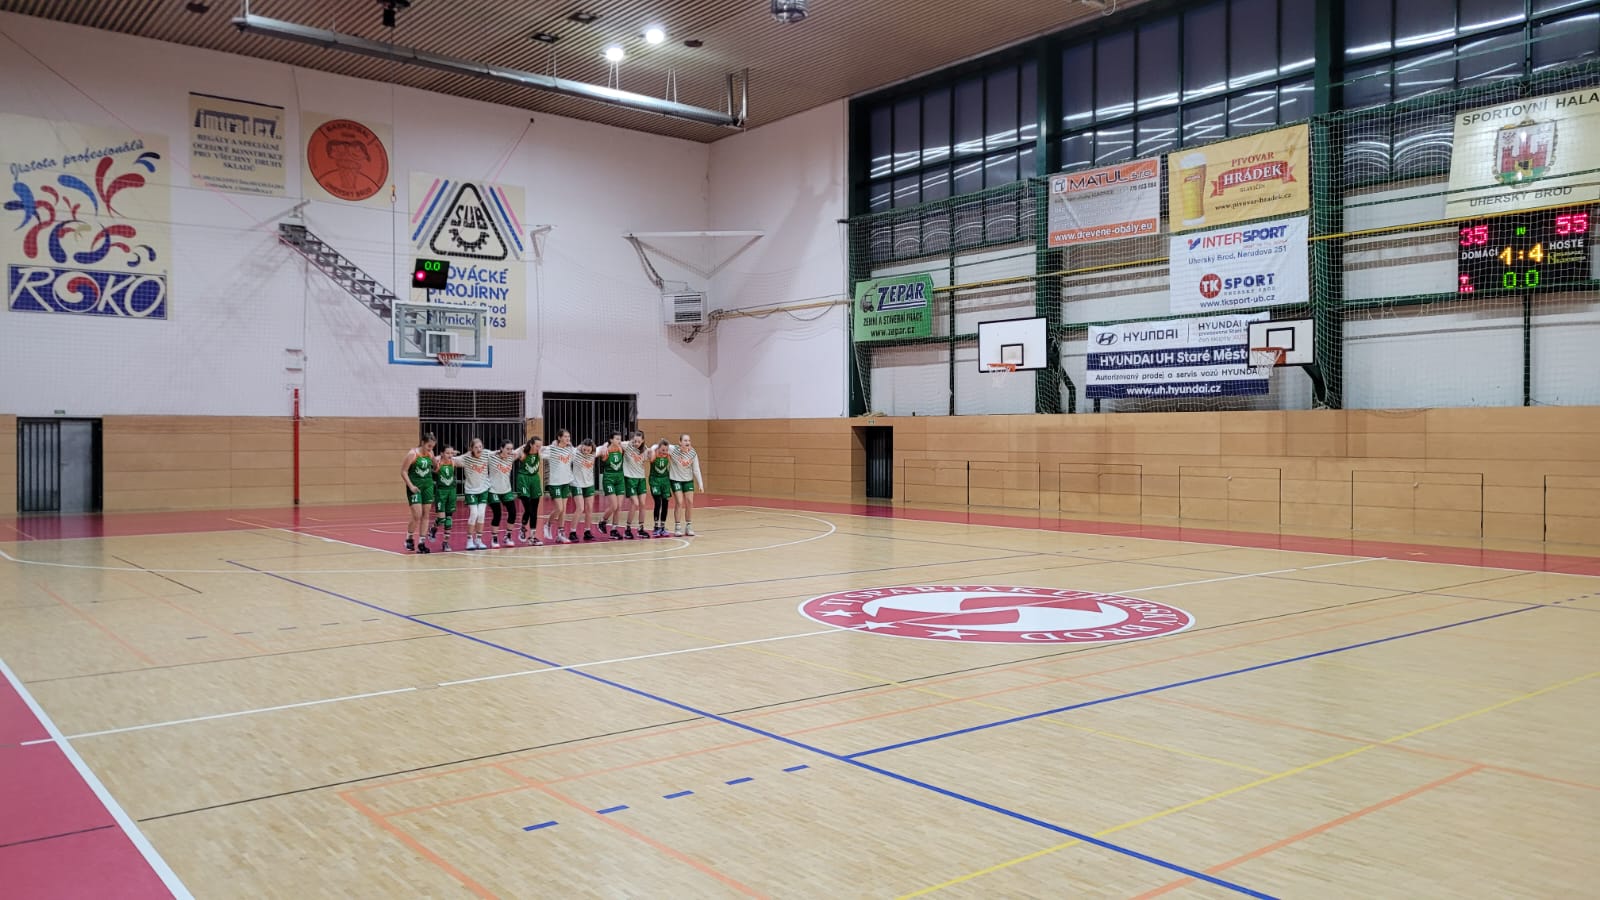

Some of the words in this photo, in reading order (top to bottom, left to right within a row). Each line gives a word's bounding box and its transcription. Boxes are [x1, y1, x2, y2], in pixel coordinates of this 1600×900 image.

[1462, 99, 1548, 126] SPORTOVNÍ
[1556, 92, 1600, 108] HALA
[1231, 152, 1275, 167] PIVOVAR
[10, 159, 57, 181] Jistota
[1070, 170, 1129, 190] MATUL
[1223, 163, 1282, 186] HRÁDEK
[1470, 191, 1528, 207] UHERSKÝ
[1535, 187, 1573, 199] BROD
[451, 205, 488, 230] SUB
[1557, 214, 1588, 234] 55
[1054, 222, 1153, 242] www.drevene-obaly.eu
[1202, 225, 1288, 249] INTERSPORT
[1460, 225, 1488, 246] 35
[1188, 255, 1215, 265] Uherský
[1237, 249, 1272, 258] Nerudova
[1274, 245, 1287, 253] 251
[1461, 247, 1499, 260] DOMÁCÍ
[424, 261, 441, 271] 0.0
[447, 265, 508, 284] OVÁCKÉ
[9, 267, 167, 317] ROKO
[429, 282, 509, 301] ROJÍRNY
[1201, 280, 1220, 293] TK
[1224, 273, 1275, 289] SPORT
[877, 283, 925, 311] ZEPAR
[1200, 294, 1276, 308] www.tksport-ub.cz
[1123, 329, 1179, 342] HYUNDAI
[1198, 321, 1242, 330] HYUNDAI
[1100, 352, 1154, 367] HYUNDAI
[1156, 351, 1174, 364] UH
[1177, 349, 1210, 363] Staré
[1095, 372, 1139, 382] Autorizovaný
[1142, 371, 1165, 381] prodej
[1176, 370, 1198, 378] servis
[1201, 368, 1219, 377] vozů
[1127, 383, 1222, 396] www.uh.hyundai.cz
[845, 585, 1035, 600] SPARTAK
[1047, 590, 1184, 627] UHERSKÝ
[1020, 624, 1162, 641] BROD
